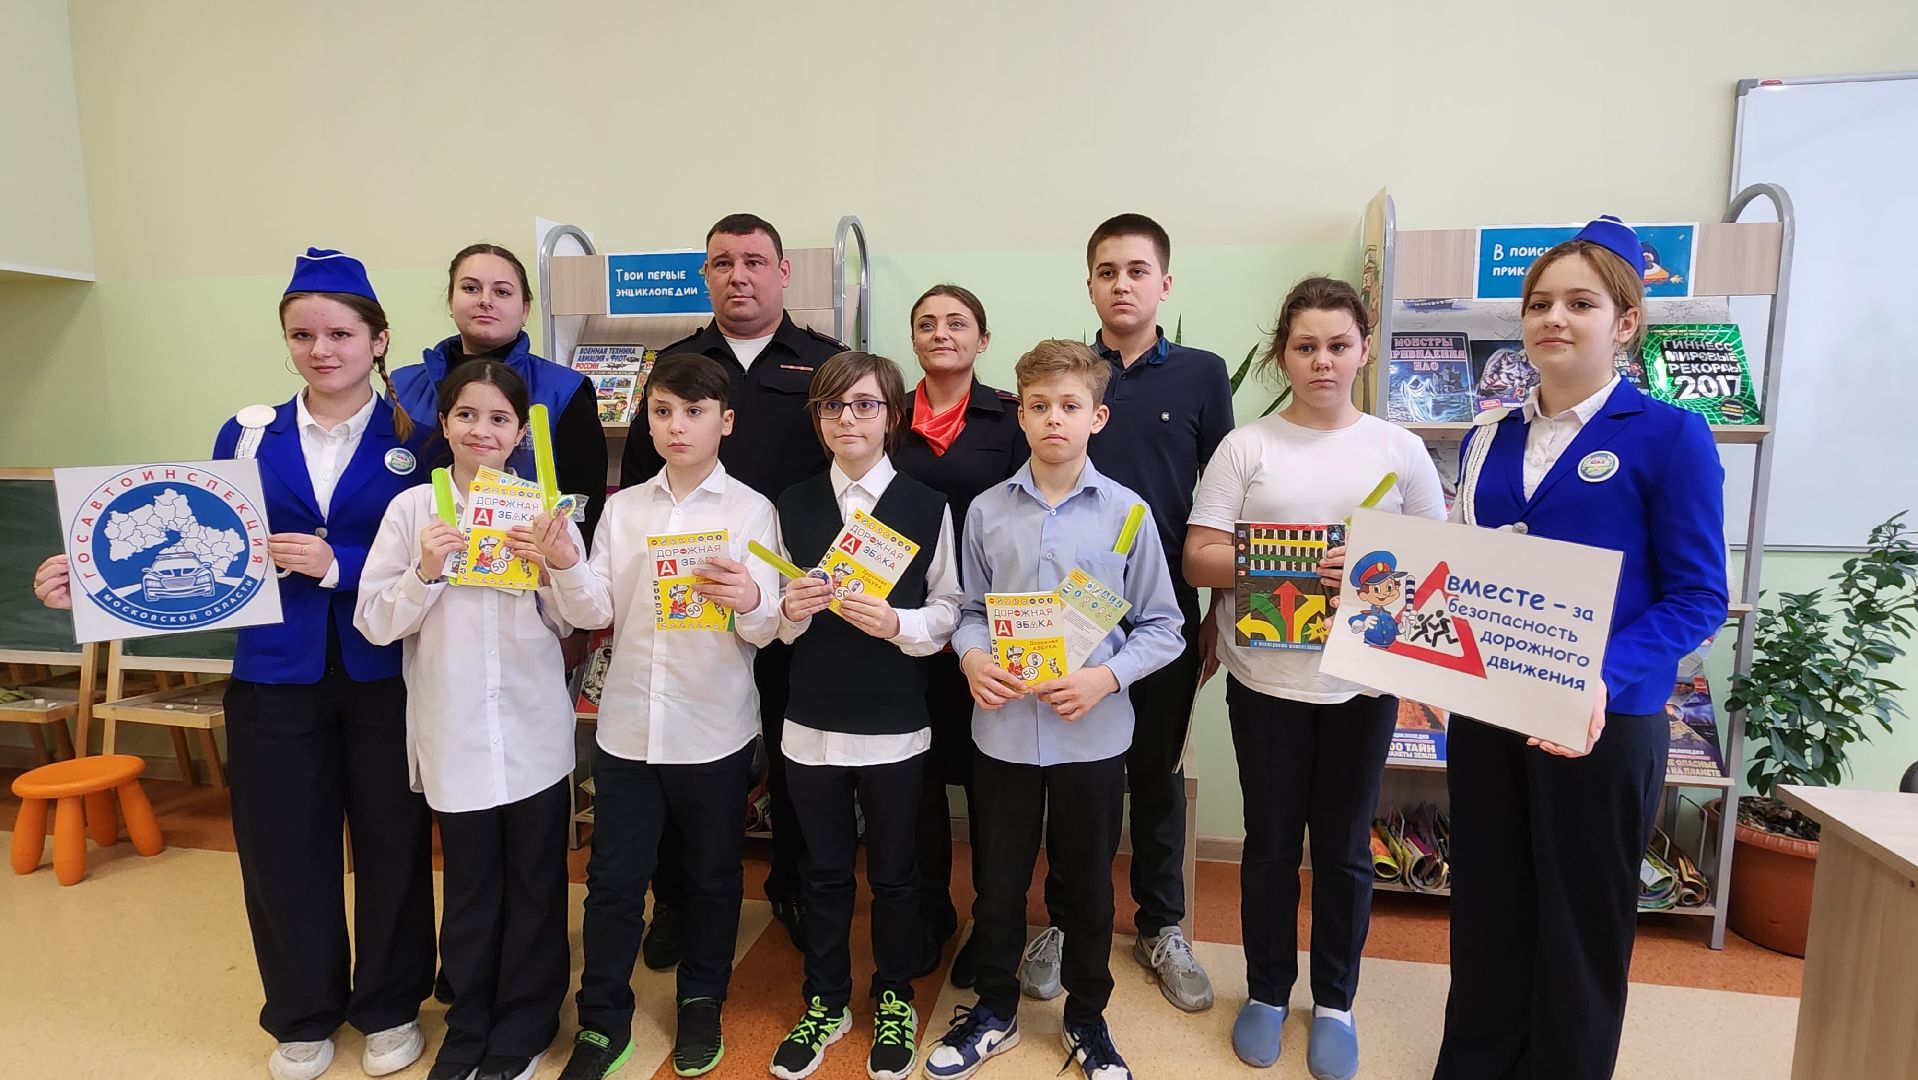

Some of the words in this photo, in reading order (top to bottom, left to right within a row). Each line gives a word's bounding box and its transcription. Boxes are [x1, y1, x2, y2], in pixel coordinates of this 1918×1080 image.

[1494, 244, 1504, 261] В
[647, 269, 686, 281] ПЕРВЫЕ
[615, 285, 698, 298] ЭНЦИКЛОПЕДИИ
[1394, 338, 1454, 347] МОНСТРЫ
[1662, 340, 1734, 351] ГИННЕСС
[577, 355, 606, 363] АВИАЦИЯ
[1664, 351, 1739, 362] МИРОВЫЕ
[1413, 361, 1439, 371] НЛО
[1667, 363, 1742, 374] РЕКОРДЫ
[1674, 375, 1742, 400] 2017
[476, 497, 539, 511] ДОРОЖНАЯ
[77, 469, 264, 579] ГОСАВТОИНСПЕКЦИЯ
[1250, 528, 1328, 541] ПРАВИЛА
[850, 524, 904, 560] ДОРОЖНАЯ
[656, 545, 721, 559] ДОРОЖНАЯ
[1250, 543, 1328, 559] ДОРОЖНОГО
[492, 560, 506, 572] 50
[1250, 560, 1317, 573] ДВИЖЕНИ
[103, 593, 198, 622] МОСКОВСКОЙ
[204, 579, 256, 617] ОБЛАСТИ
[687, 604, 700, 616] 50
[994, 608, 1054, 618] ДОРОЖНАЯ
[1572, 606, 1594, 622] за
[1448, 599, 1580, 643] безопасность
[1480, 629, 1590, 668] дорожного
[1024, 667, 1036, 678] 50
[1487, 654, 1586, 691] движения
[1390, 742, 1403, 751] 00
[1404, 743, 1436, 753] ТАЙН
[1675, 759, 1718, 769] ОПАСНЫЕ
[1683, 768, 1722, 777] ПЛАНЕТЕ
